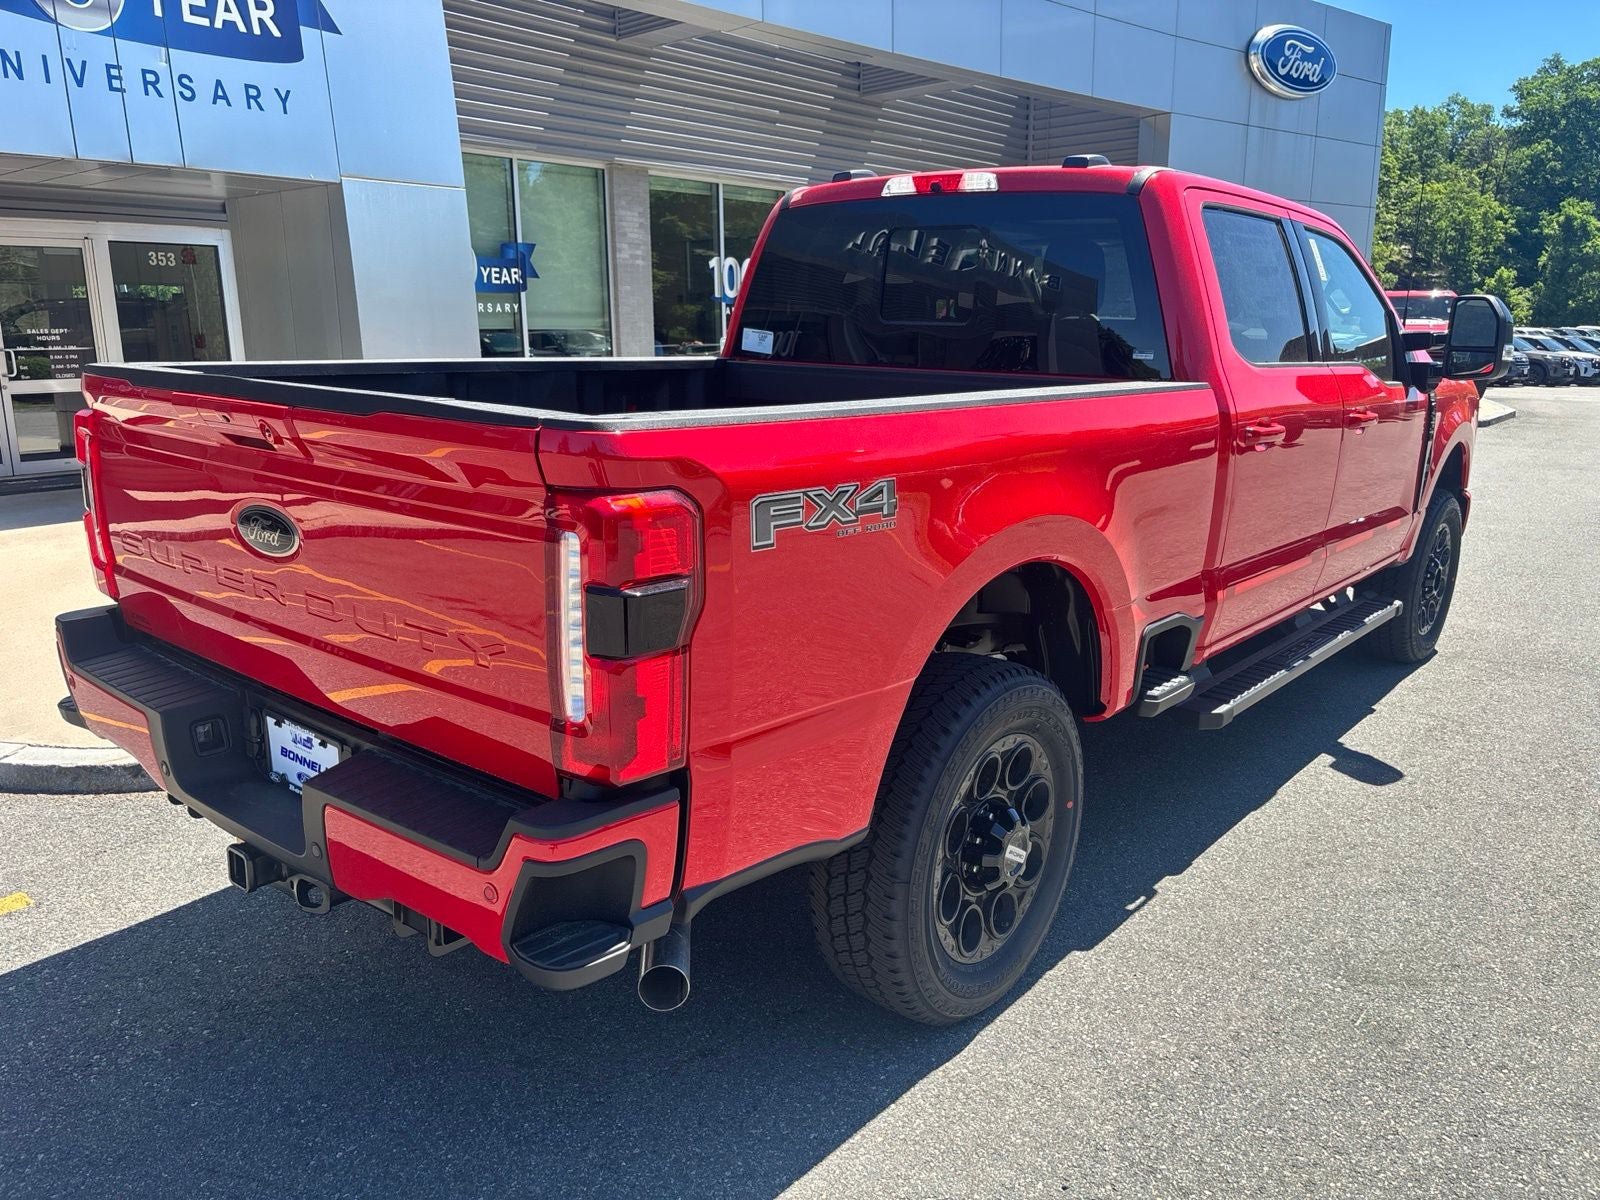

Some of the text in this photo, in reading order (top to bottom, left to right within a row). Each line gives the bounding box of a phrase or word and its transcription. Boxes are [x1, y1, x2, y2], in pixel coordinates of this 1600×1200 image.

[1278, 40, 1325, 83] Ford
[148, 251, 176, 267] 353
[480, 266, 523, 285] YEAR
[478, 302, 520, 313] RSARY
[751, 477, 898, 552] FX4
[248, 515, 281, 547] Ford
[836, 520, 897, 538] OFF ROAD
[120, 529, 506, 670] SUPER DUTY
